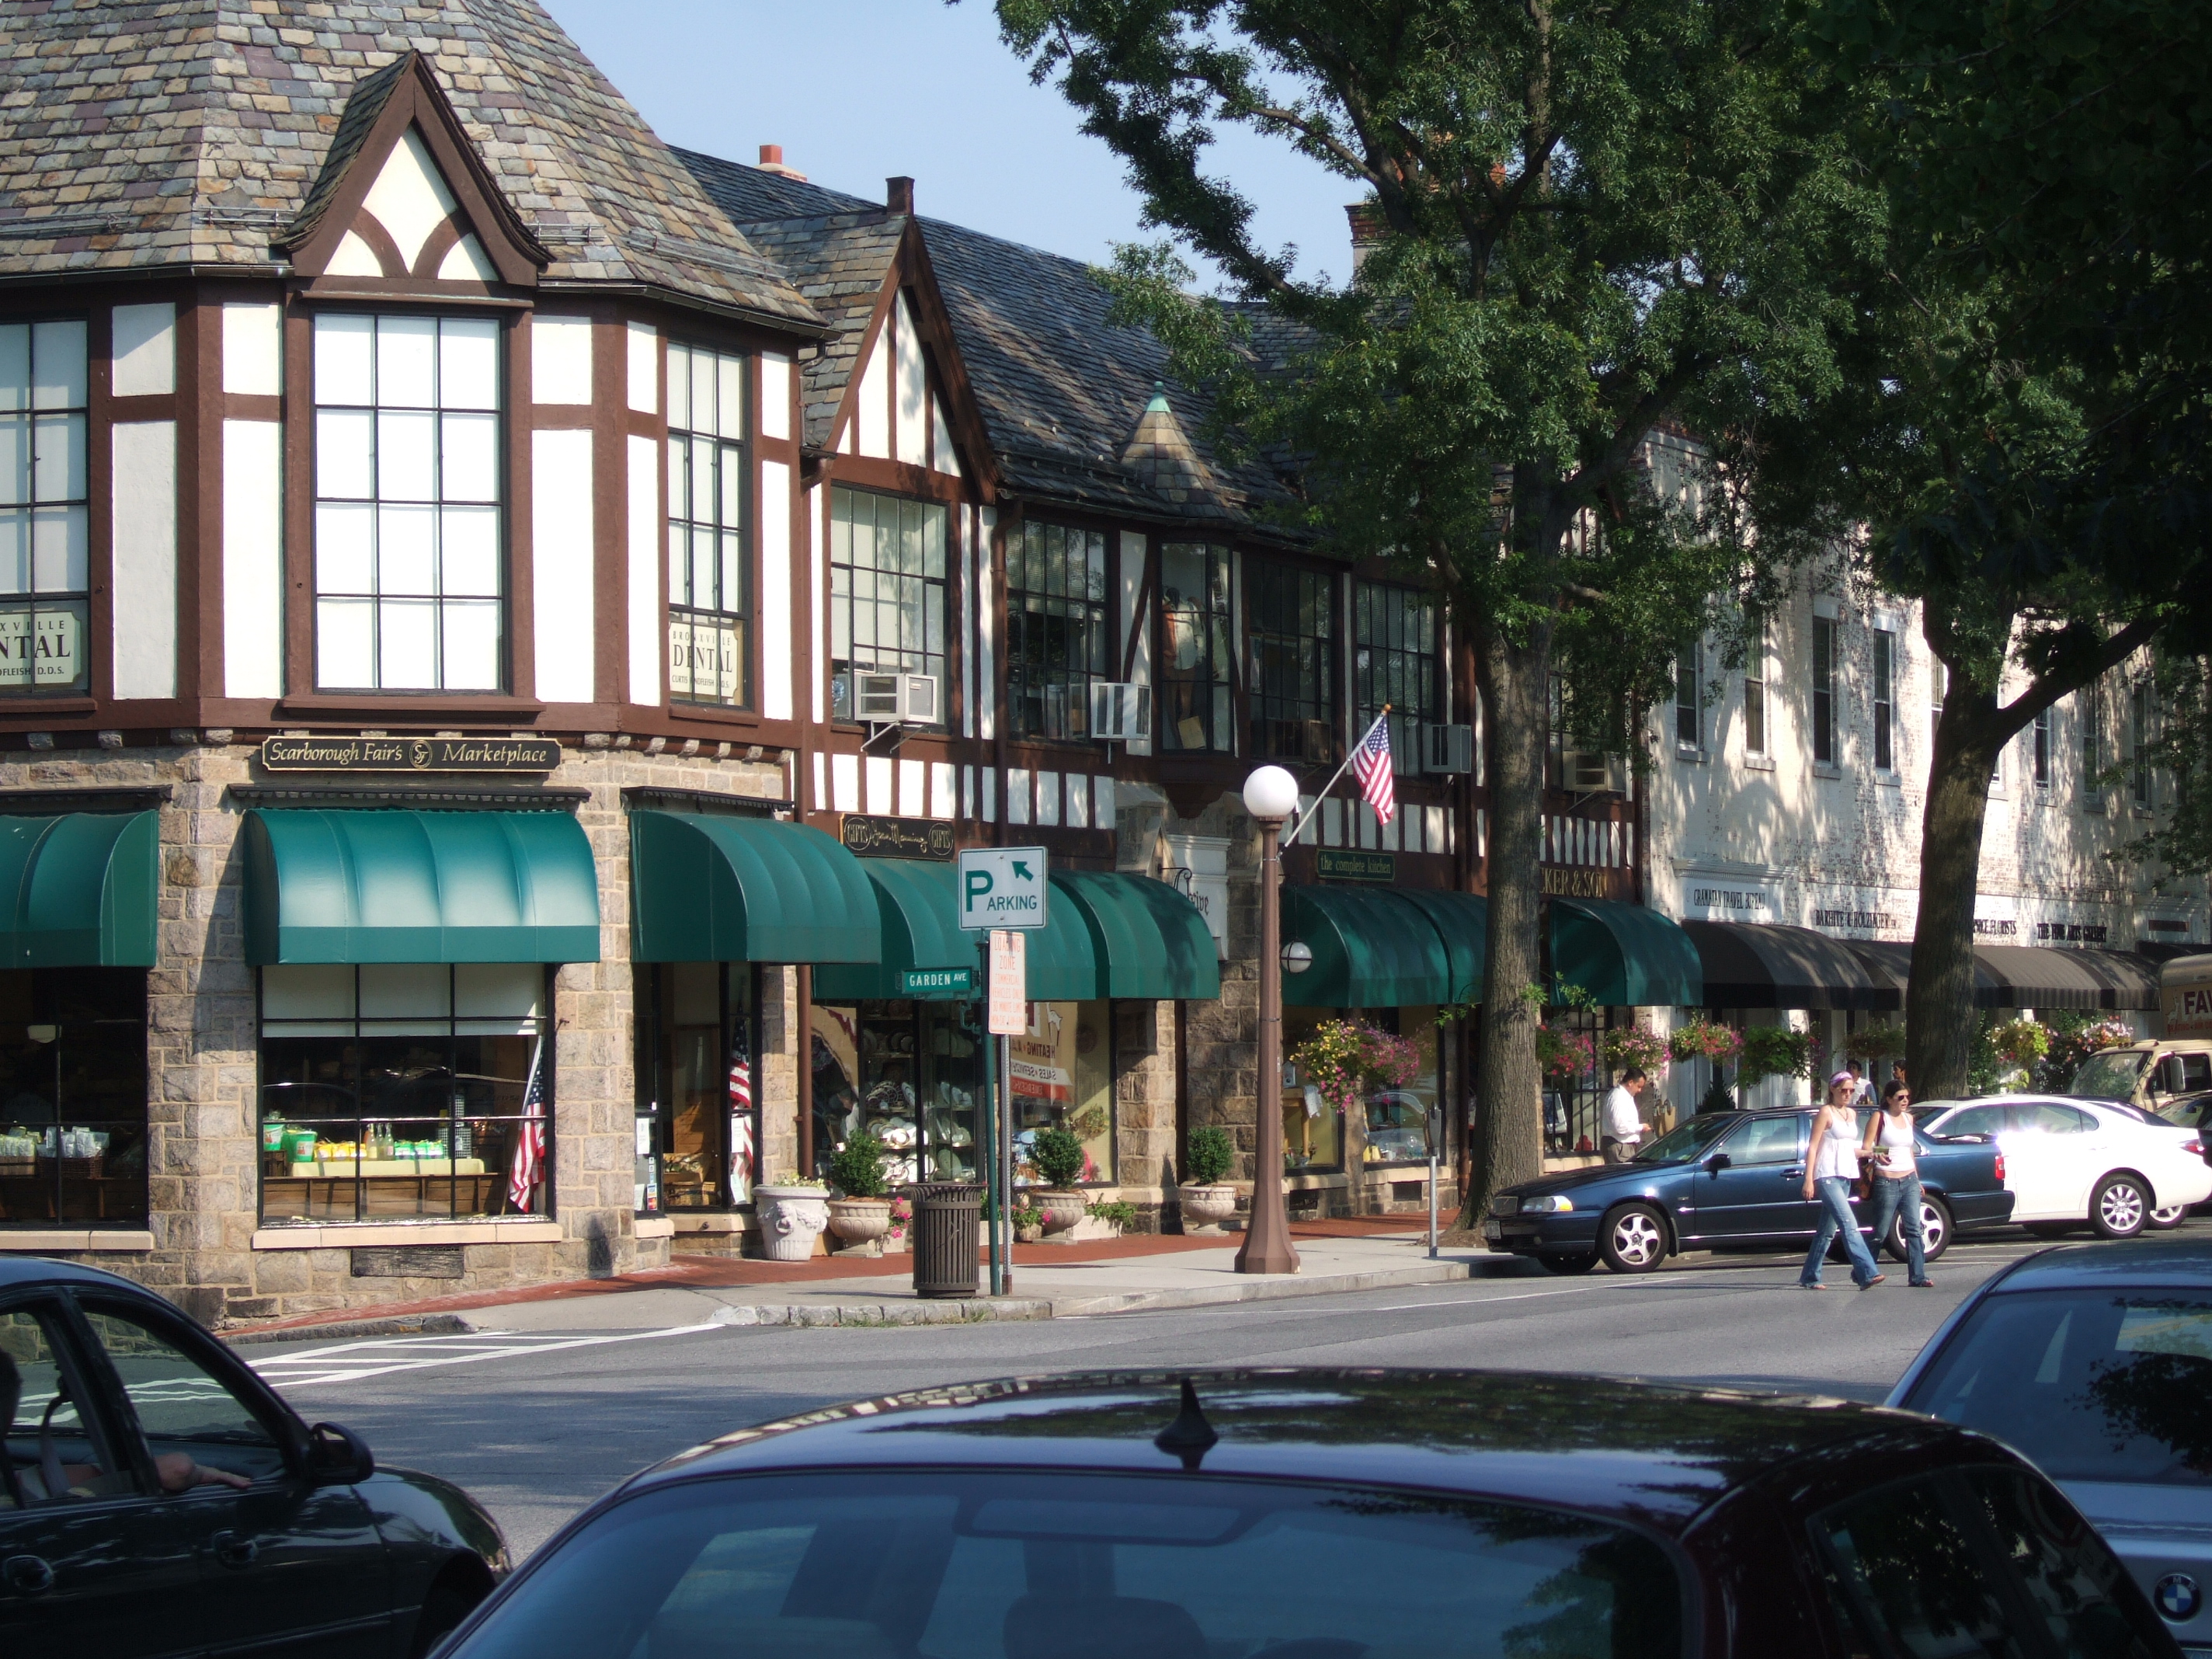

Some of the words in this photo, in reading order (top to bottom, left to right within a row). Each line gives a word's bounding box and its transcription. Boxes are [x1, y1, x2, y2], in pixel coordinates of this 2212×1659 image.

[270, 742, 360, 765] Scarborough
[363, 743, 402, 761] Fair's
[441, 743, 547, 766] Marketplace
[847, 823, 868, 843] GIFTS
[932, 829, 951, 849] GIFTS
[1320, 854, 1333, 871] the
[1336, 857, 1365, 875] complete
[1368, 857, 1391, 875] kitchen
[965, 870, 1038, 913] PARKING
[1571, 870, 1582, 897] &
[1584, 871, 1608, 899] SON
[1723, 890, 1744, 909] TRAVEL
[1745, 892, 1766, 910] BUREAU
[2036, 923, 2050, 940] THE
[994, 936, 1021, 953] LOANG
[1000, 955, 1016, 970] ZONE
[909, 972, 951, 987] GARDEN
[953, 972, 967, 982] AVE
